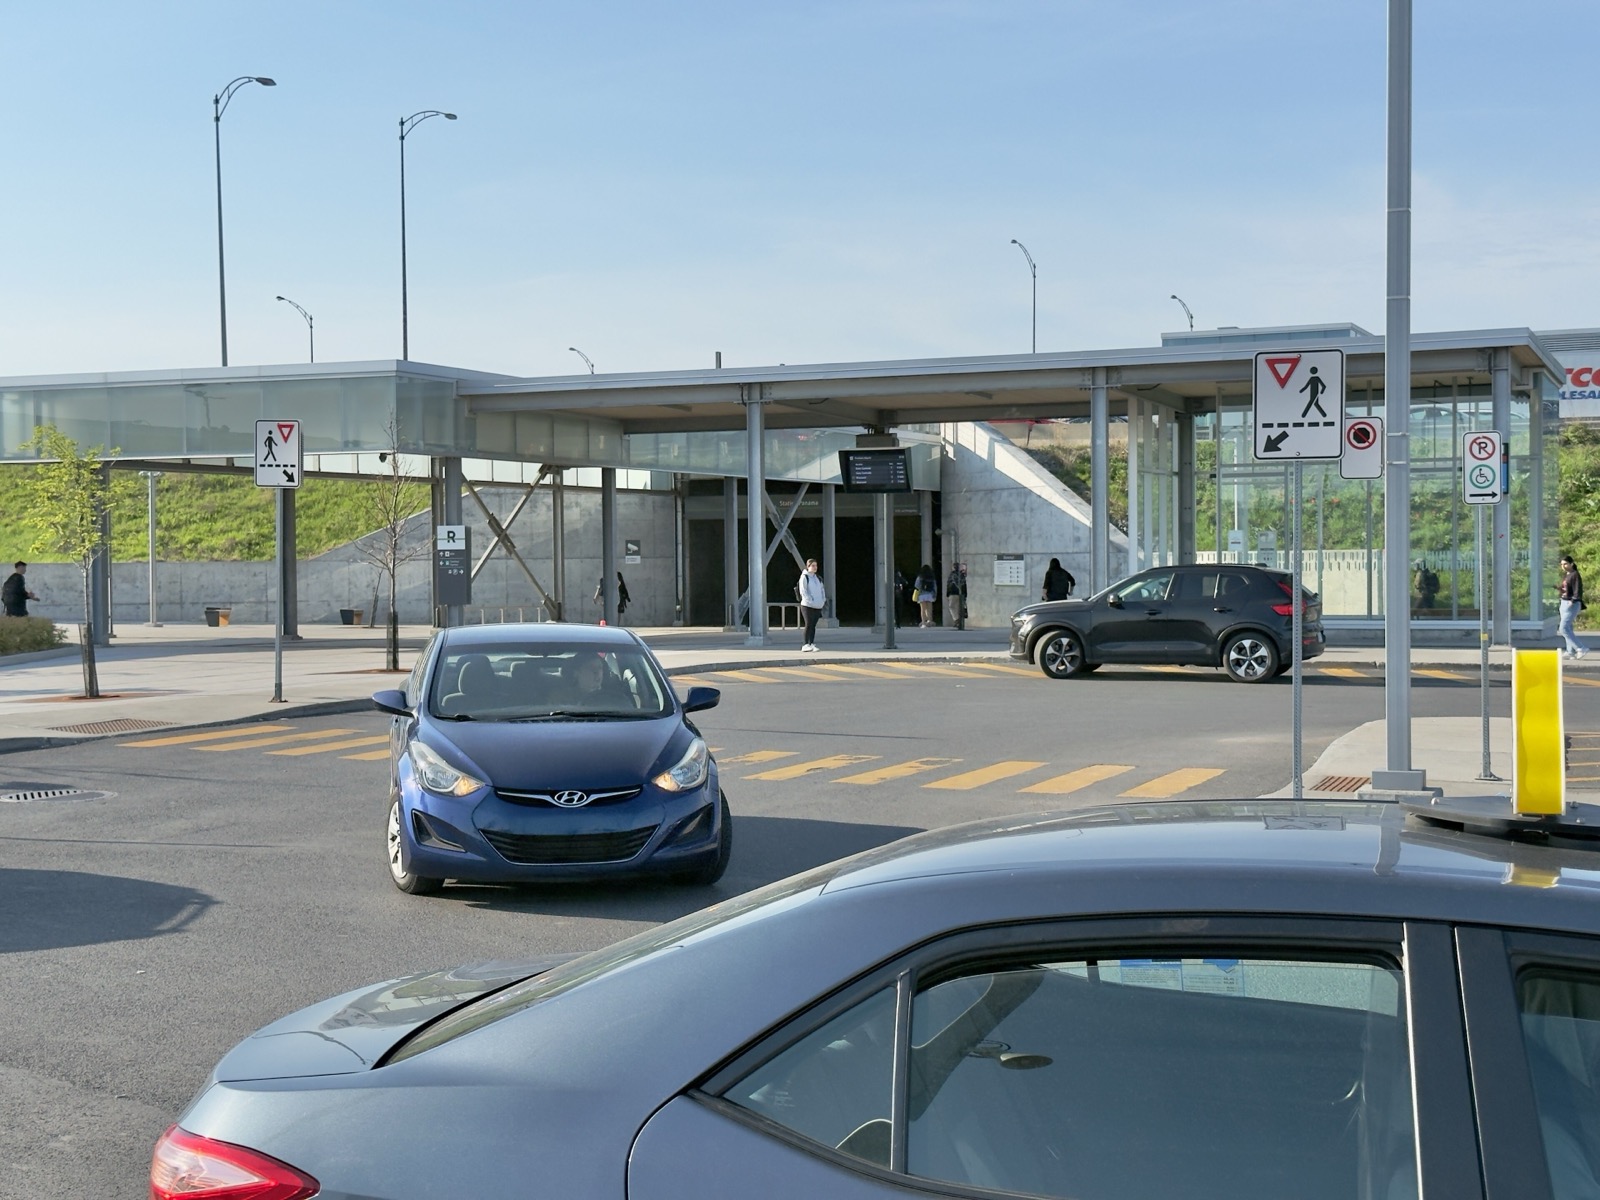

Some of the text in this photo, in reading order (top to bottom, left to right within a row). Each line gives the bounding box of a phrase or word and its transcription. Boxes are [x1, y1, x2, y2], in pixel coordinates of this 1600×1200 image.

[1559, 390, 1600, 400] LESA
[1478, 441, 1488, 455] P
[447, 531, 456, 543] R
